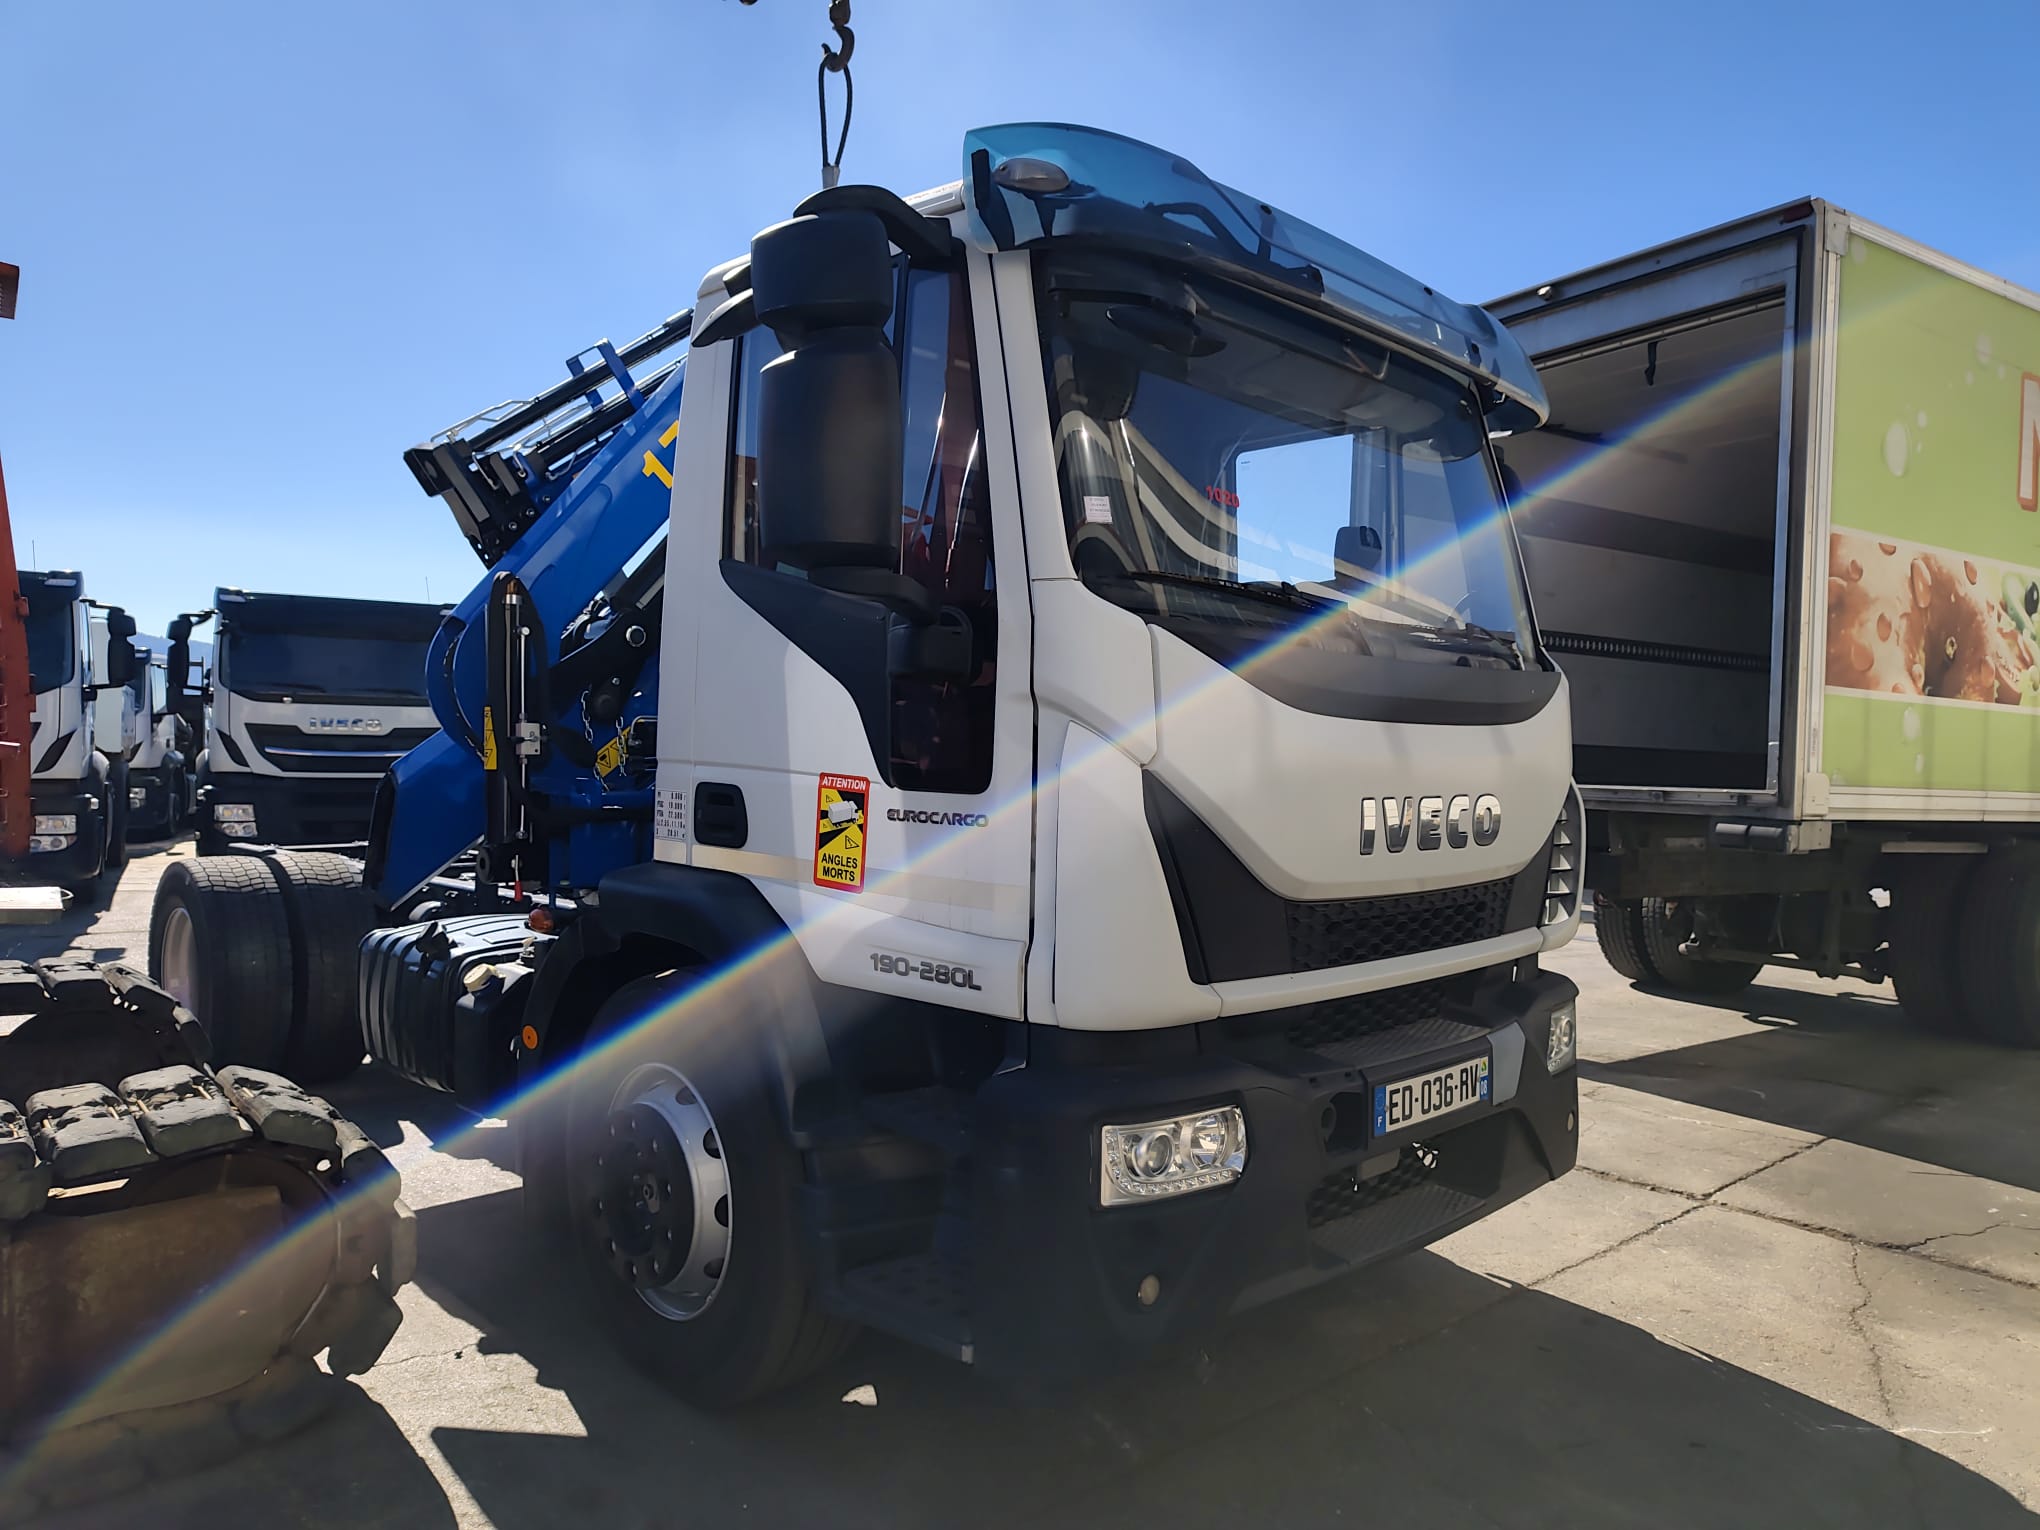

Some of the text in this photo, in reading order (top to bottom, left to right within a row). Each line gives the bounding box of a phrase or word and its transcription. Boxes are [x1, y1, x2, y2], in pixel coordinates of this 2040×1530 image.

[822, 776, 866, 791] ATTENTION
[887, 808, 989, 827] EUROCARGO
[1360, 793, 1502, 855] IVECO
[821, 852, 858, 869] ANGLES
[822, 865, 855, 882] MORTS
[870, 953, 982, 991] 190-280L
[1377, 1116, 1382, 1127] F
[1480, 1079, 1488, 1096] 08
